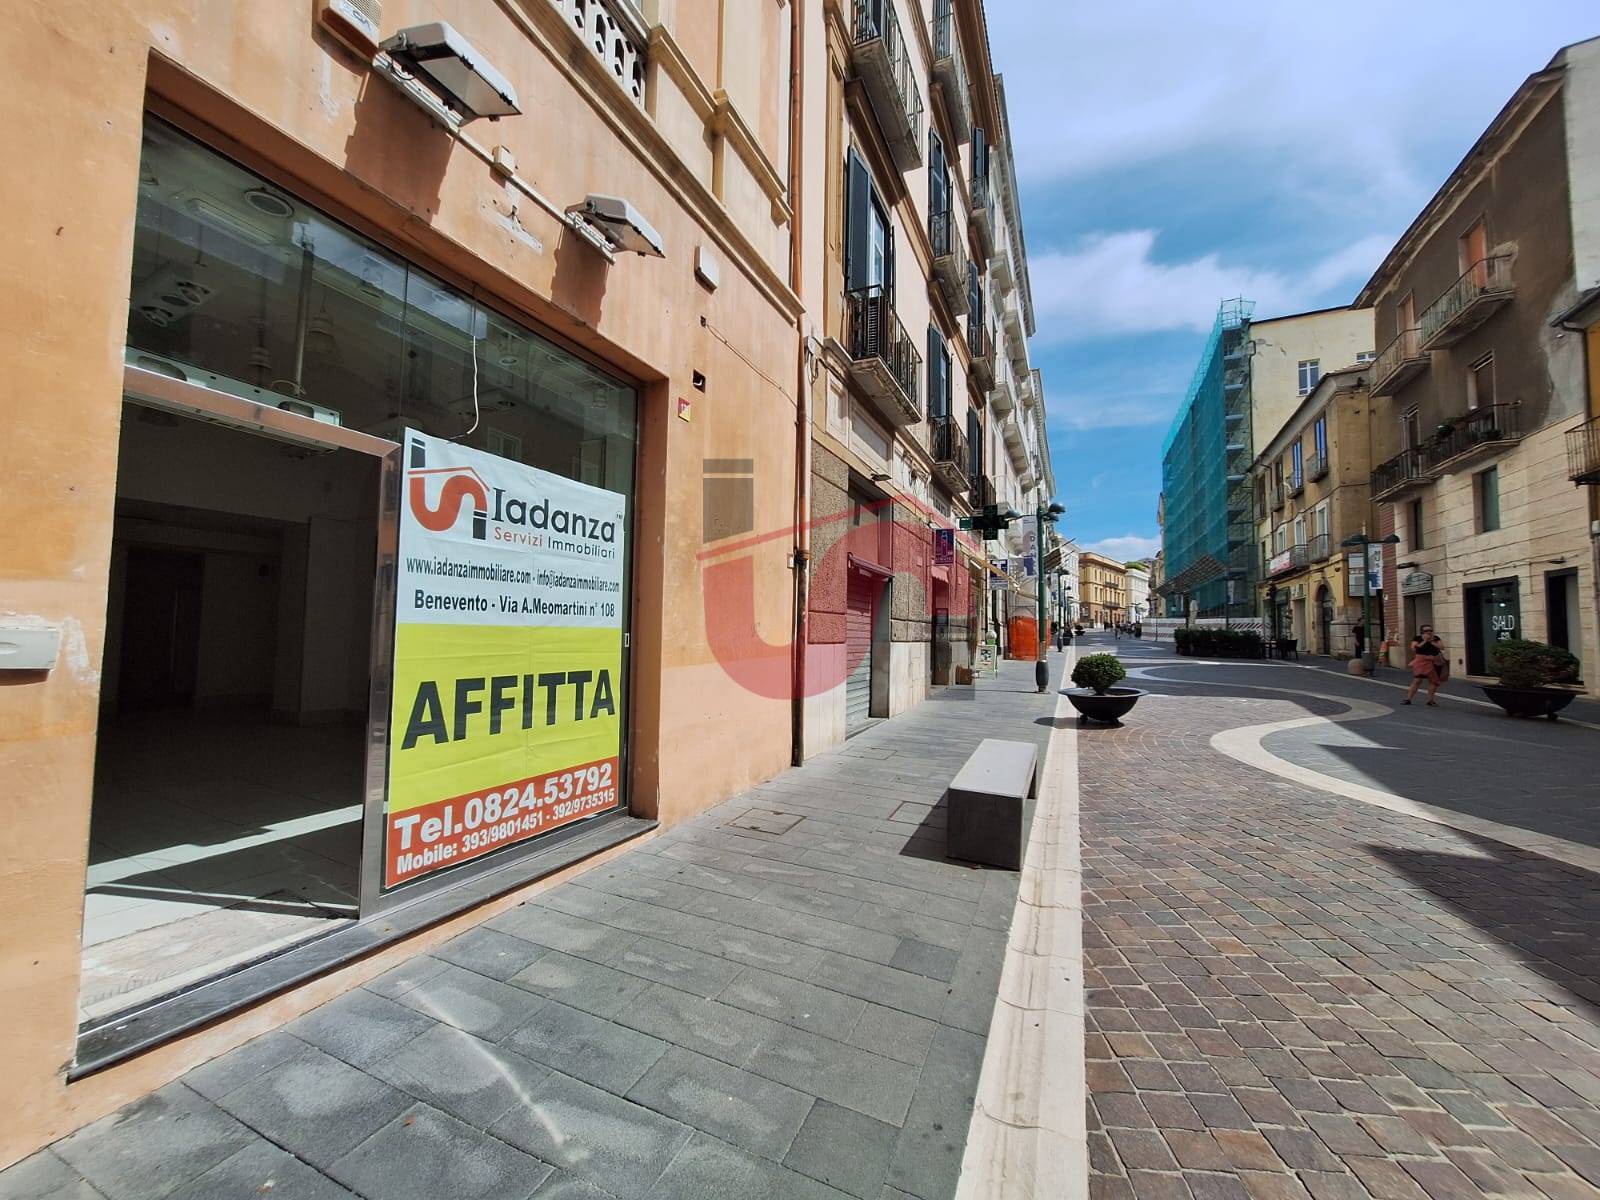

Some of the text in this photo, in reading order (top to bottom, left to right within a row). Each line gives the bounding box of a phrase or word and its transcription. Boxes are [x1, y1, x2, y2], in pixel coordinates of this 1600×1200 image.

[491, 487, 615, 543] Iadanza
[494, 526, 615, 559] Servizi Immobiliari
[406, 556, 531, 584] www.iadanzaimmobiliare.com
[414, 589, 488, 611] Benevento
[499, 595, 518, 613] Via
[600, 603, 615, 617] 108
[400, 669, 616, 750] AFFITTA
[396, 843, 458, 875] Mobile:
[461, 810, 543, 853] 393/9801451
[552, 788, 615, 820] 392/9735315
